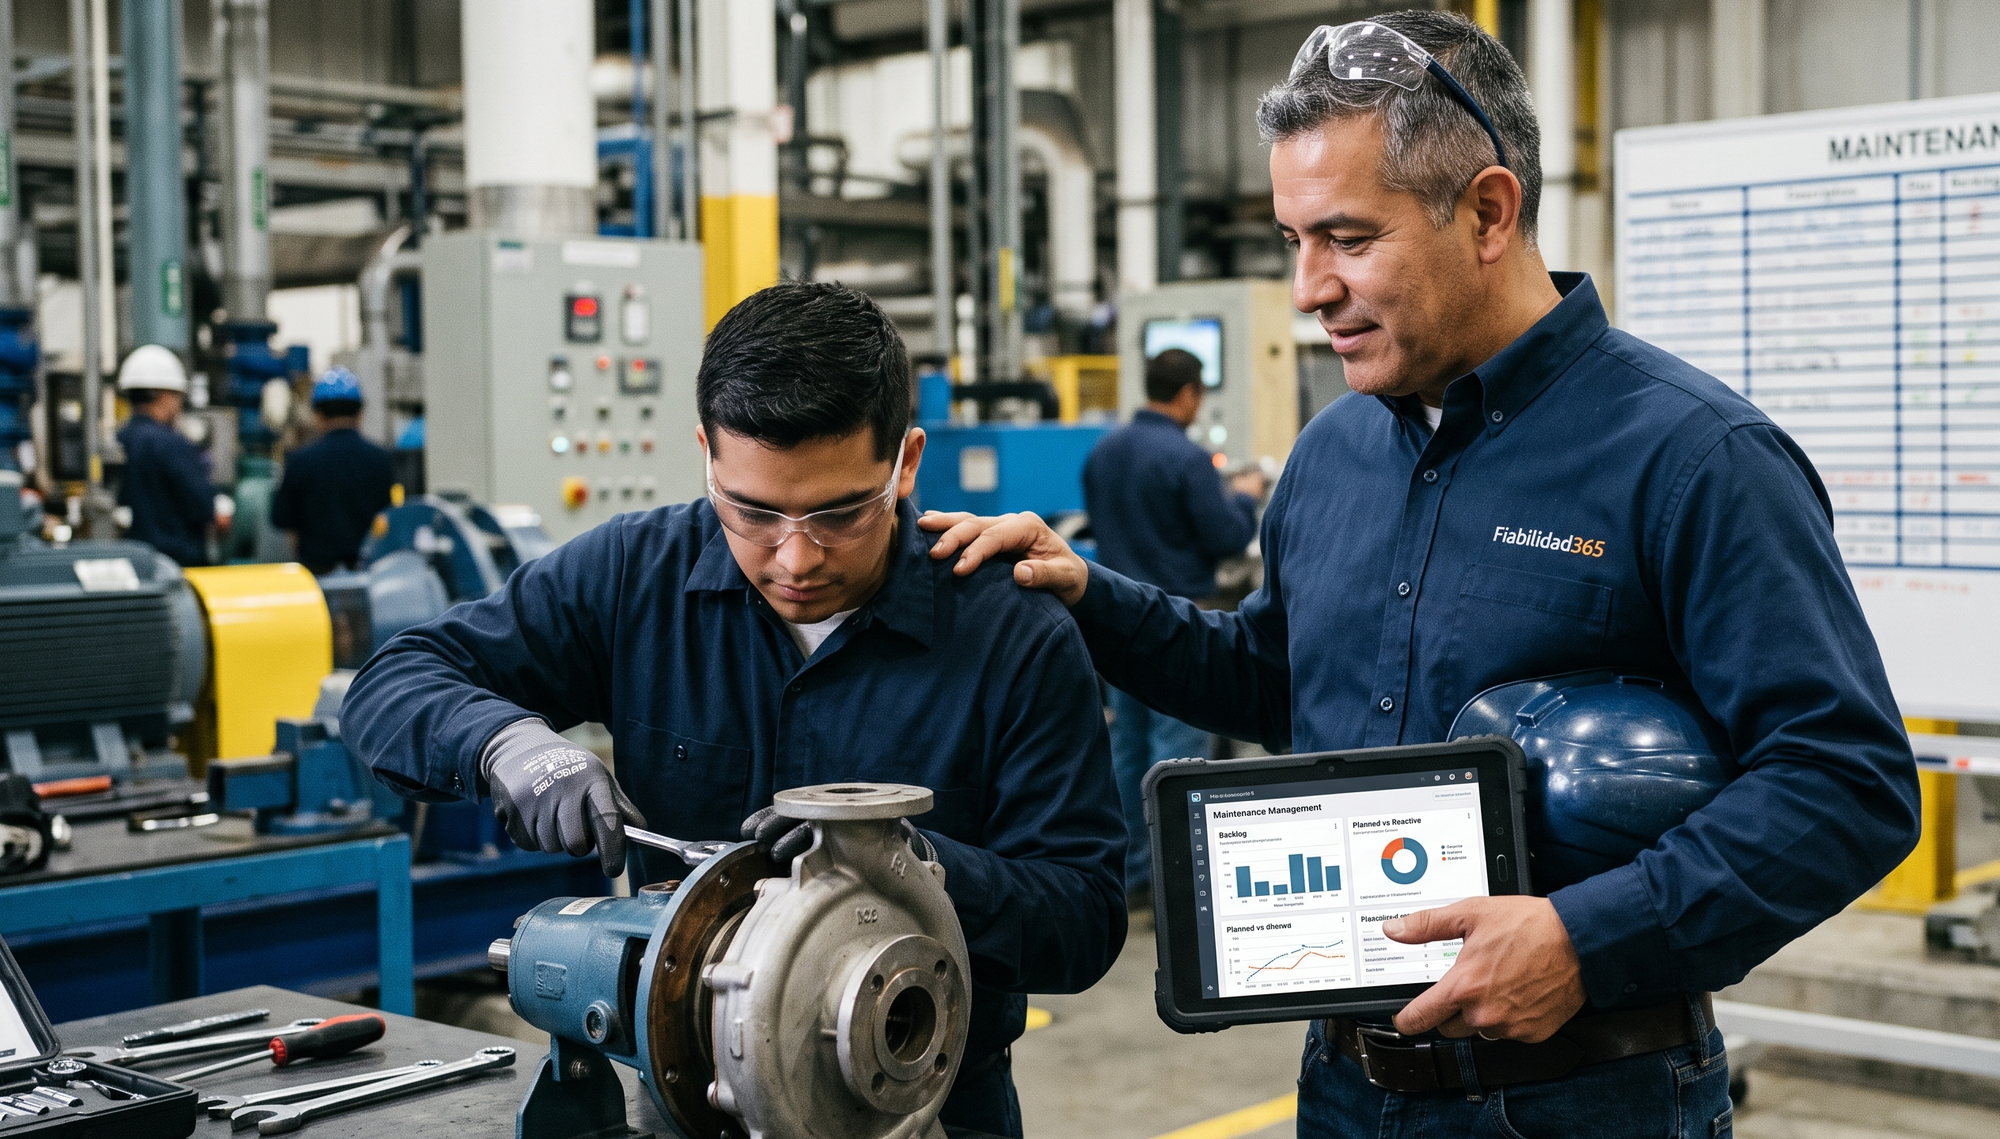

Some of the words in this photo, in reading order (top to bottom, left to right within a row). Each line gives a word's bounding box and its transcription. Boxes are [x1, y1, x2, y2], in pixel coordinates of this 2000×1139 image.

[1493, 526, 1606, 558] Fiabilidad365
[1213, 809, 1266, 819] Maintenance
[1268, 803, 1322, 816] Management
[1352, 818, 1381, 828] Planned
[1392, 817, 1422, 825] Reactive
[1219, 831, 1247, 839] Backlog
[1226, 925, 1255, 933] Planned
